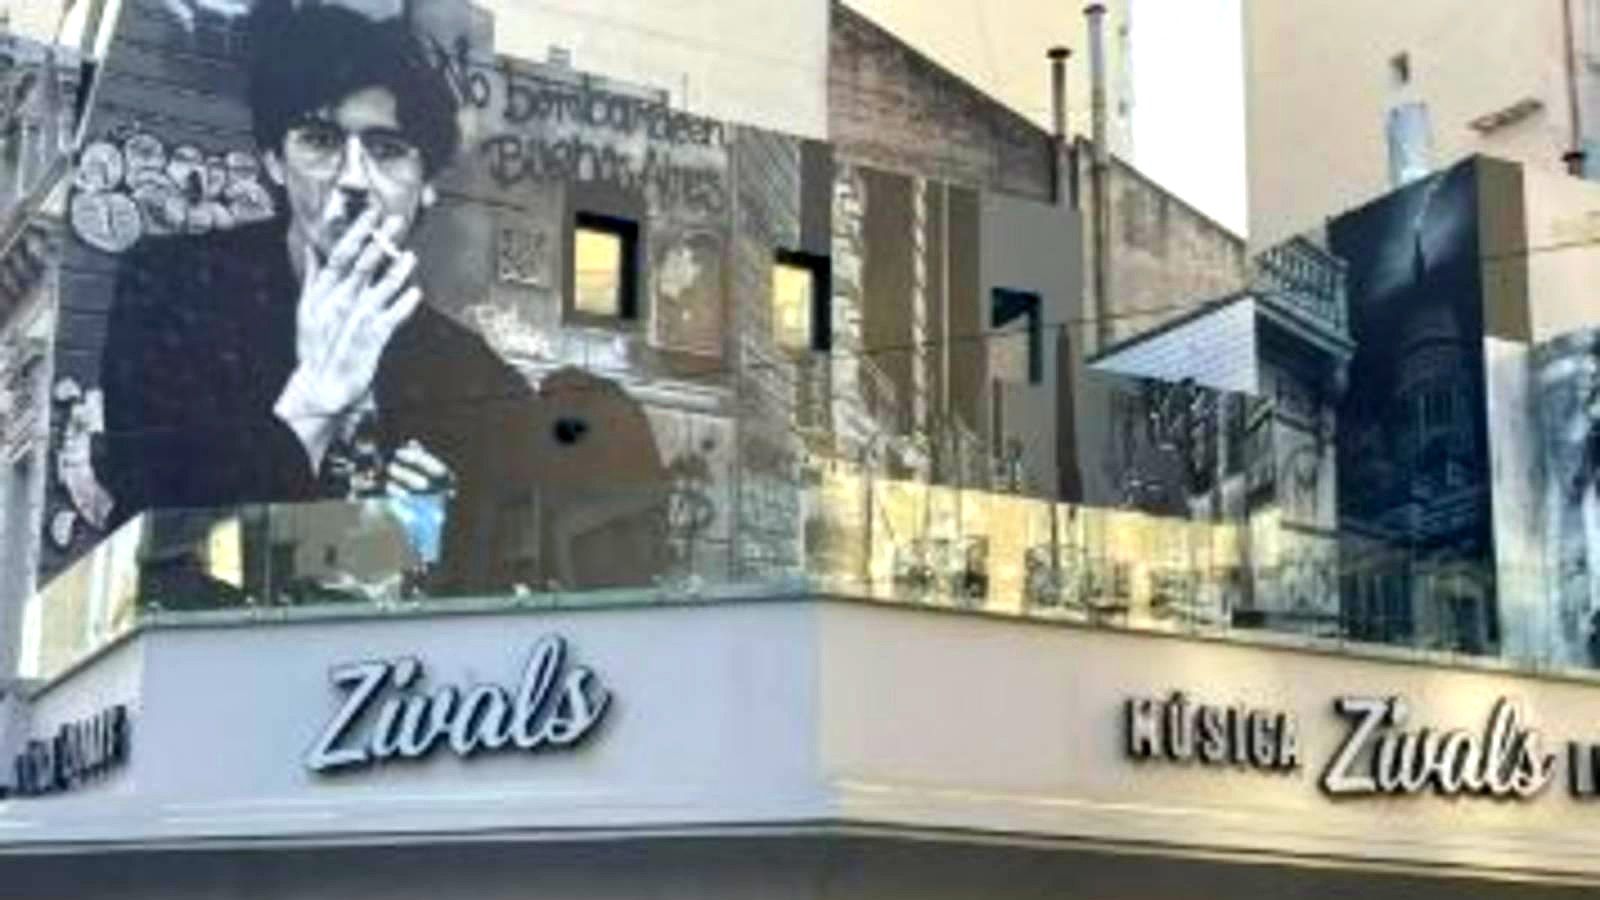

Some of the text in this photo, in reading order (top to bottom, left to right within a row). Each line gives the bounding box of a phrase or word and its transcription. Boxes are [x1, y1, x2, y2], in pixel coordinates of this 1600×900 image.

[306, 634, 612, 776] Zivals
[1123, 691, 1303, 770] MÚSICA
[1318, 694, 1556, 801] Zivals
